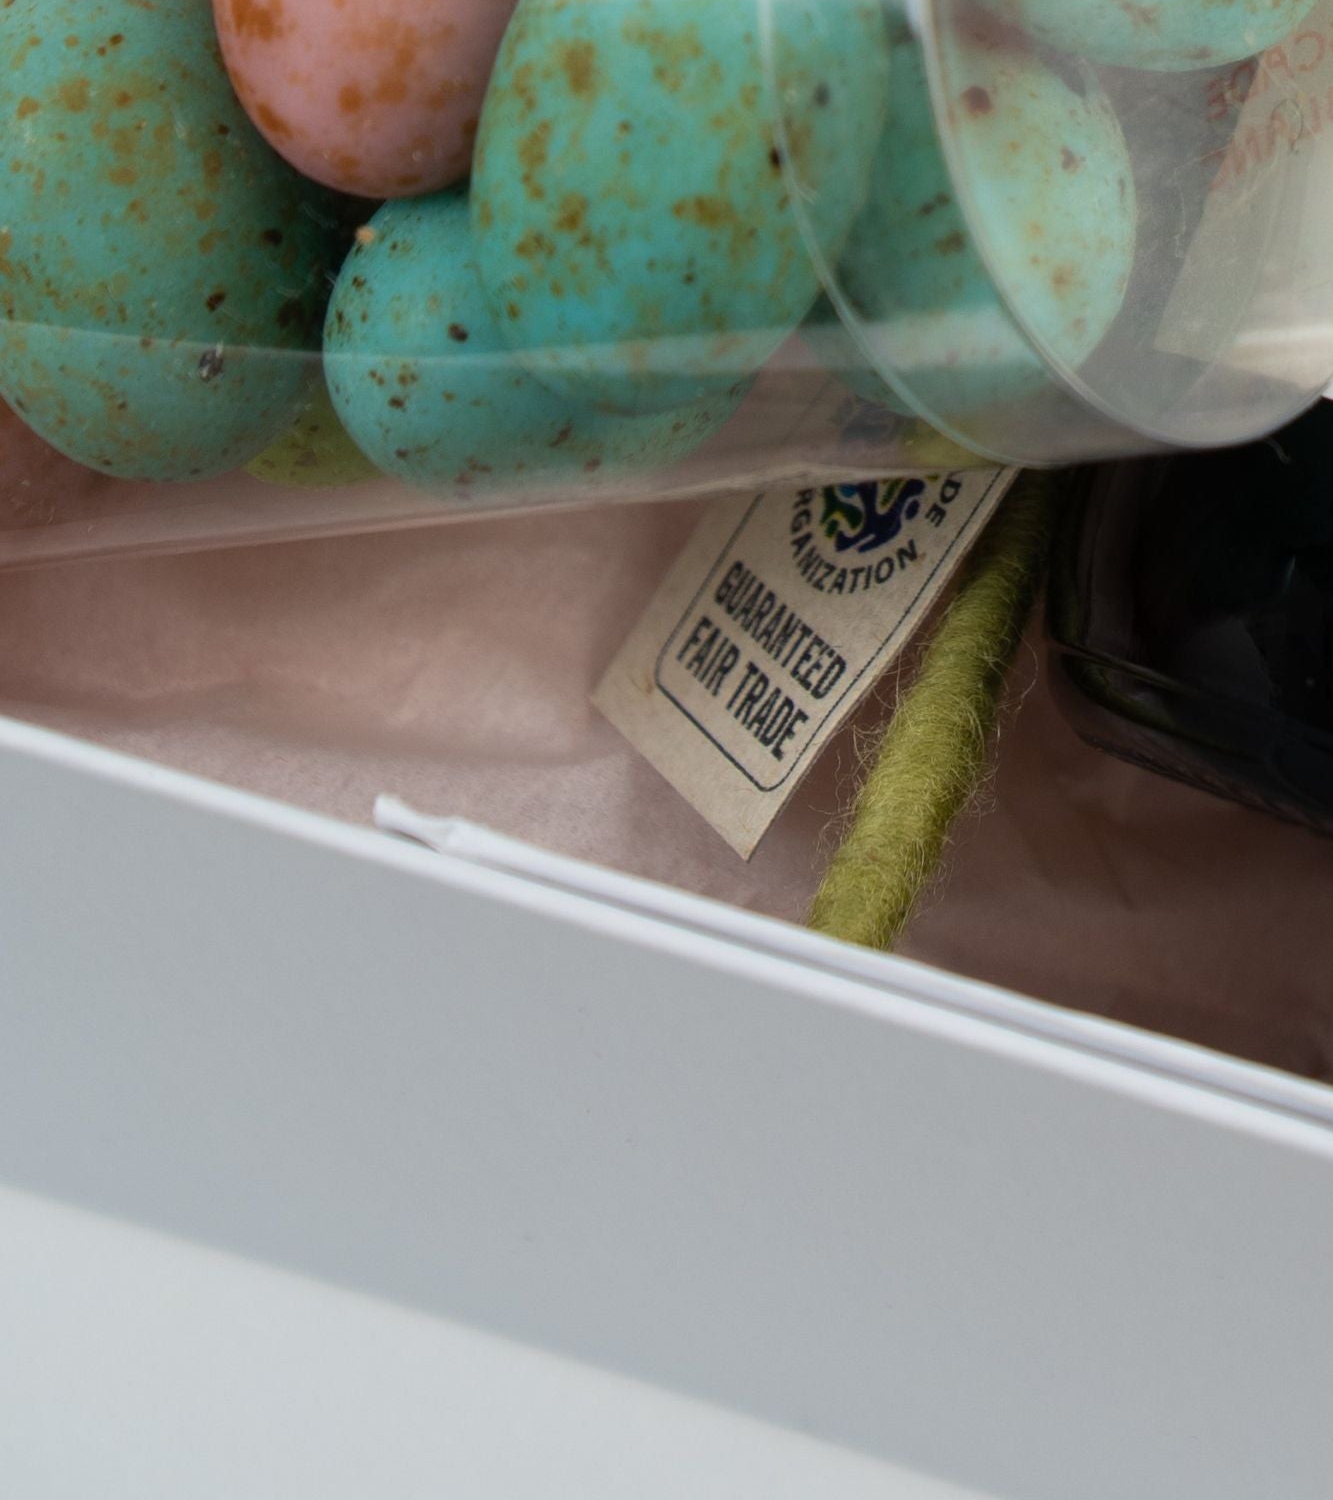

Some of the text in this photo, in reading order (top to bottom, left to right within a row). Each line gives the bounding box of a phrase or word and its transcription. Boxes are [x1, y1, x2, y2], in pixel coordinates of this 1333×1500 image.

[790, 486, 919, 595] RGANIZATION
[675, 615, 809, 762] FAIR TRADE
[713, 560, 847, 701] GUARANTEED
